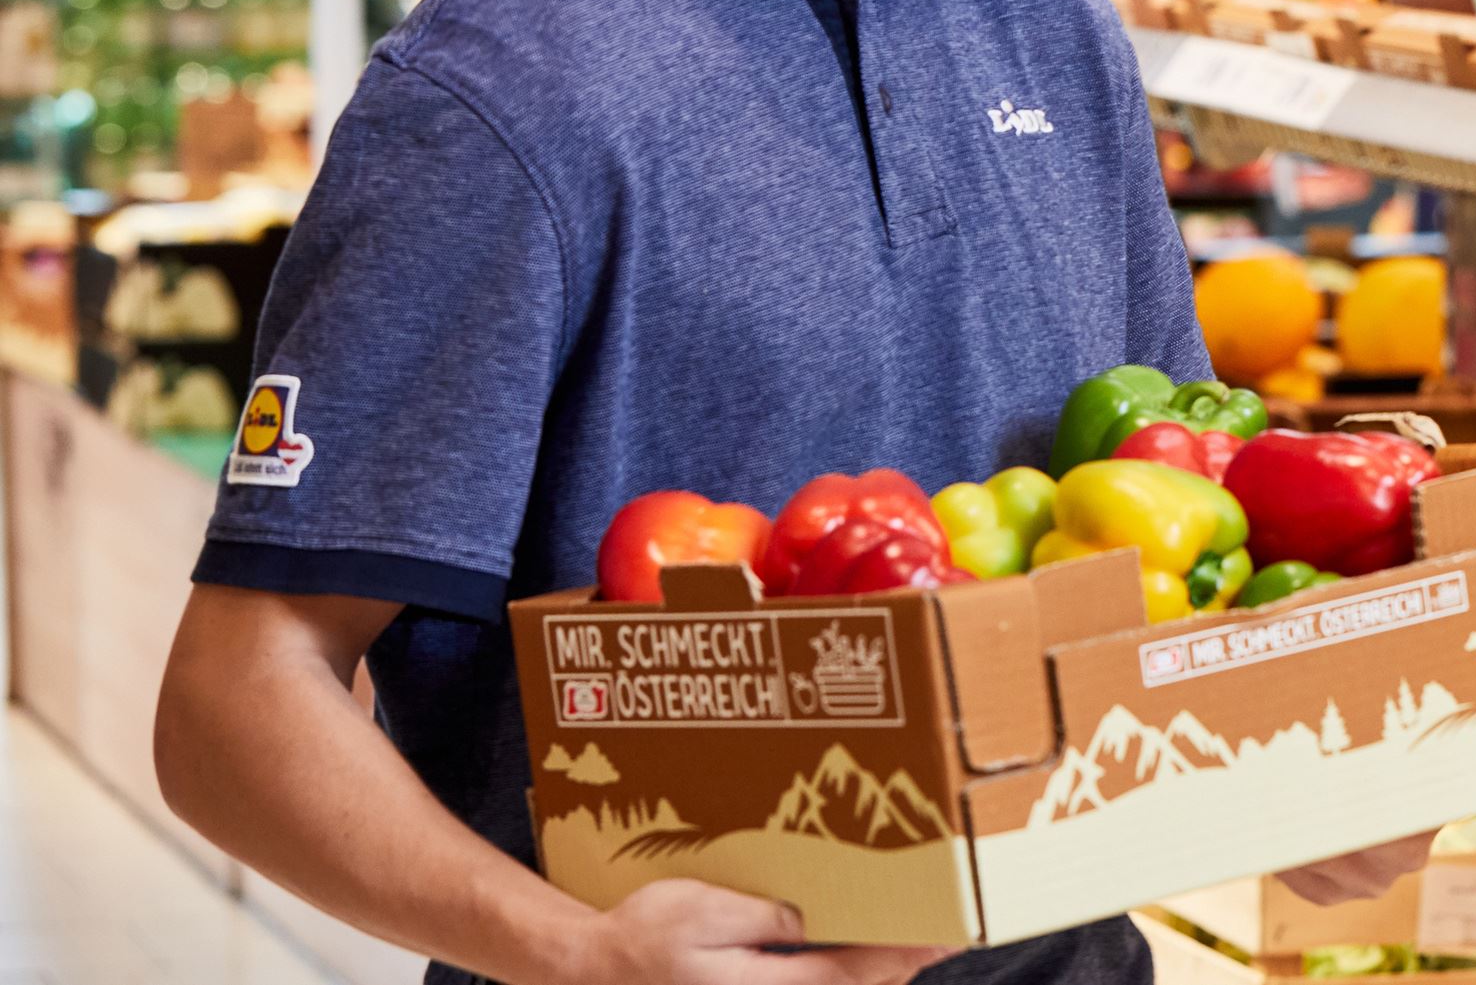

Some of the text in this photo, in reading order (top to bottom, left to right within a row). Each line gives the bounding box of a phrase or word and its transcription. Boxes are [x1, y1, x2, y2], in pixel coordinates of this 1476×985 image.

[555, 622, 776, 668] MIR. SCHMECKT.
[616, 669, 773, 718] ÖSTERREICH
